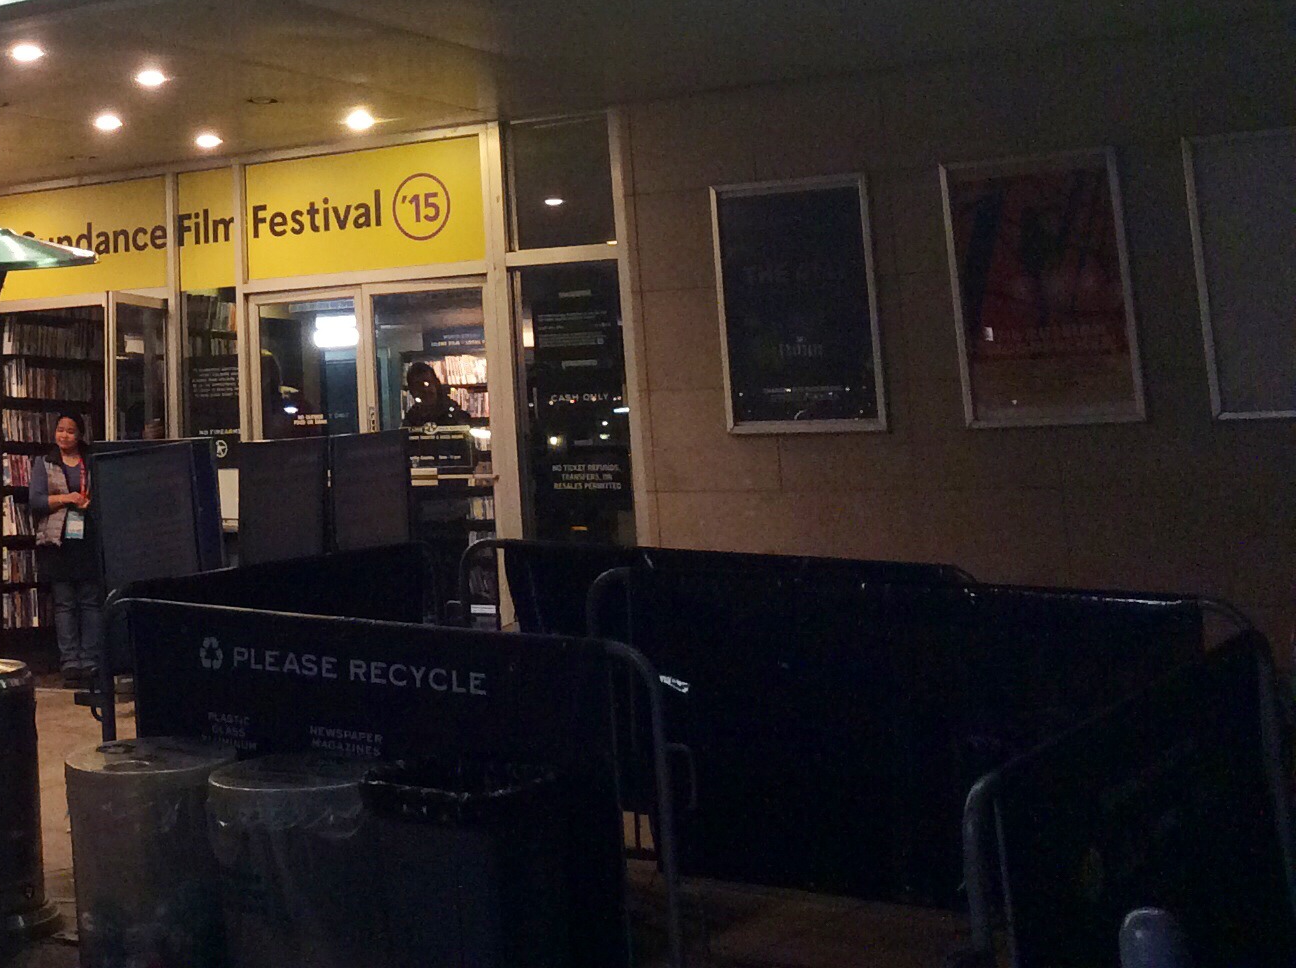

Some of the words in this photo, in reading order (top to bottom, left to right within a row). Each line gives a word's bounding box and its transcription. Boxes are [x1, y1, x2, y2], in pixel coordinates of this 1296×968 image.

[23, 222, 167, 256] ndance
[252, 189, 382, 239] Festival
[232, 646, 338, 679] PLEASE
[349, 658, 487, 696] RECYCLE
[309, 725, 384, 745] NEWSPAPER
[311, 737, 382, 758] MAGAZINES
